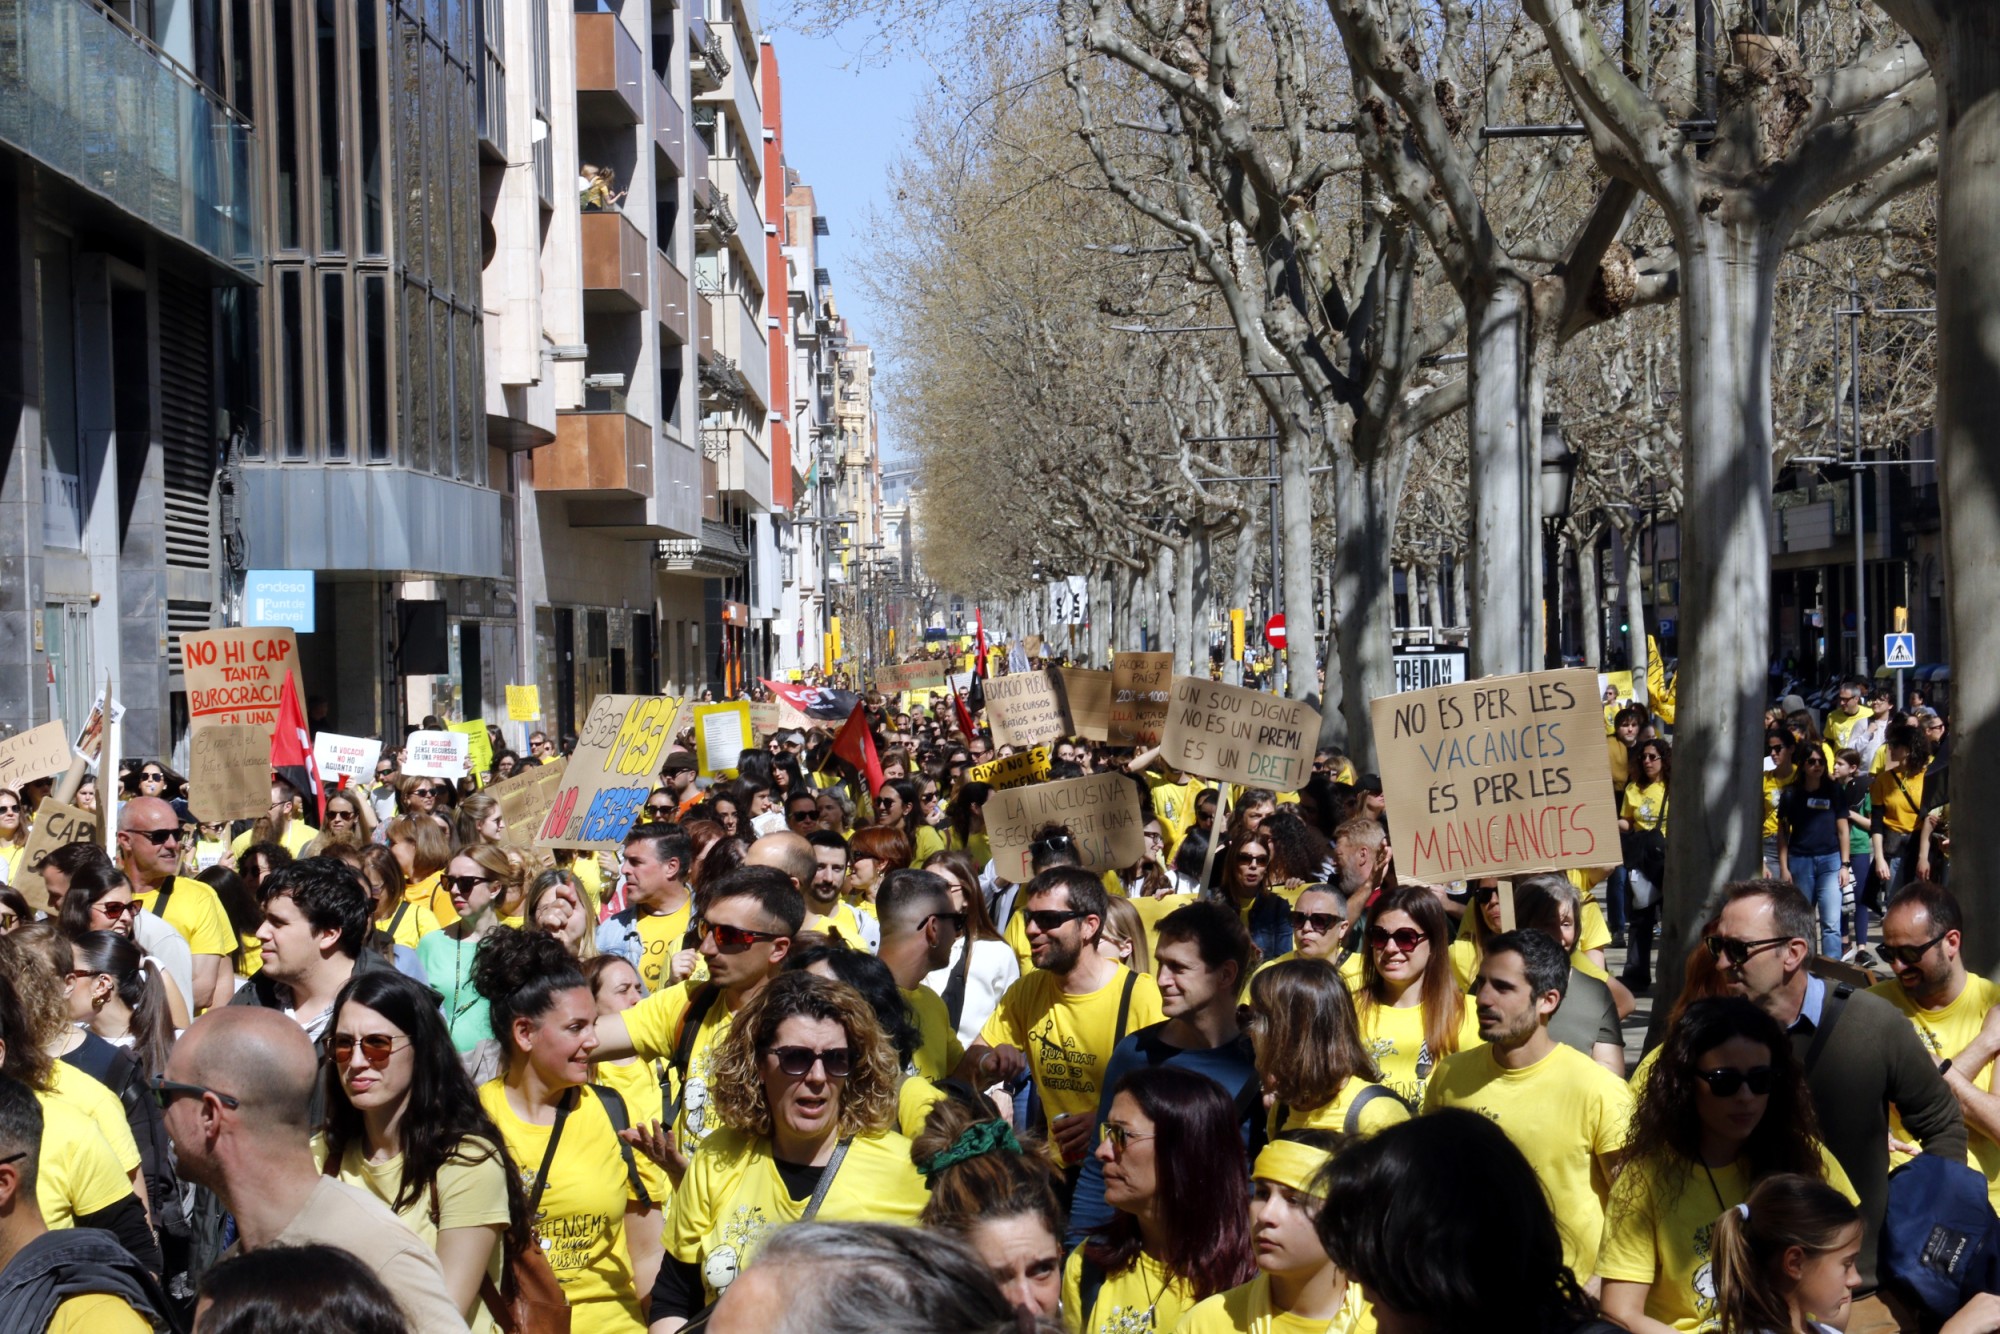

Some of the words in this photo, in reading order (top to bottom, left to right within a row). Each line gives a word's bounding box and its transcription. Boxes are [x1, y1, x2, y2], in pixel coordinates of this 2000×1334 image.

[256, 582, 305, 593] endesa
[265, 598, 290, 609] Punt
[292, 599, 305, 609] de
[264, 610, 303, 622] Servei
[186, 640, 217, 669] NO
[224, 640, 244, 665] HI
[253, 640, 291, 662] CAP
[221, 665, 270, 682] TANTA
[1119, 659, 1148, 671] ACORD
[1155, 660, 1168, 670] DE
[985, 674, 1021, 700] EDUCACIÓ
[1025, 669, 1061, 695] PÚBLICA
[785, 687, 836, 704] CGT
[1179, 685, 1200, 704] UN
[1207, 692, 1241, 713] SOU
[1251, 700, 1301, 725] DIGNE
[247, 711, 276, 724] UNA
[1394, 703, 1426, 739] NO
[1438, 694, 1464, 730] ÉS
[1474, 688, 1517, 722] PER
[1528, 682, 1576, 713] LES
[1180, 708, 1202, 728] NO
[1205, 712, 1227, 734] ÉS
[1231, 721, 1251, 739] UN
[1258, 725, 1302, 750] PREMI
[330, 745, 337, 753] LA
[339, 746, 364, 757] VOCACIÓ
[1419, 723, 1566, 773] VACANCES
[325, 762, 352, 772] AGUANTA
[354, 766, 364, 774] TOT
[346, 757, 355, 765] HO
[1007, 757, 1023, 771] NO
[1183, 737, 1207, 760] ÉS
[1217, 748, 1239, 769] UN
[1248, 751, 1295, 781] DRET
[1004, 797, 1026, 820] LA
[1038, 778, 1127, 814] INCLUSIVA
[1429, 781, 1458, 814] ÉS
[1473, 772, 1525, 806] PER
[1529, 767, 1572, 797] LES
[541, 786, 579, 840] NO
[1103, 809, 1134, 830] UNA
[1413, 803, 1595, 876] MANCANCES
[1047, 1063, 1066, 1075] NO
